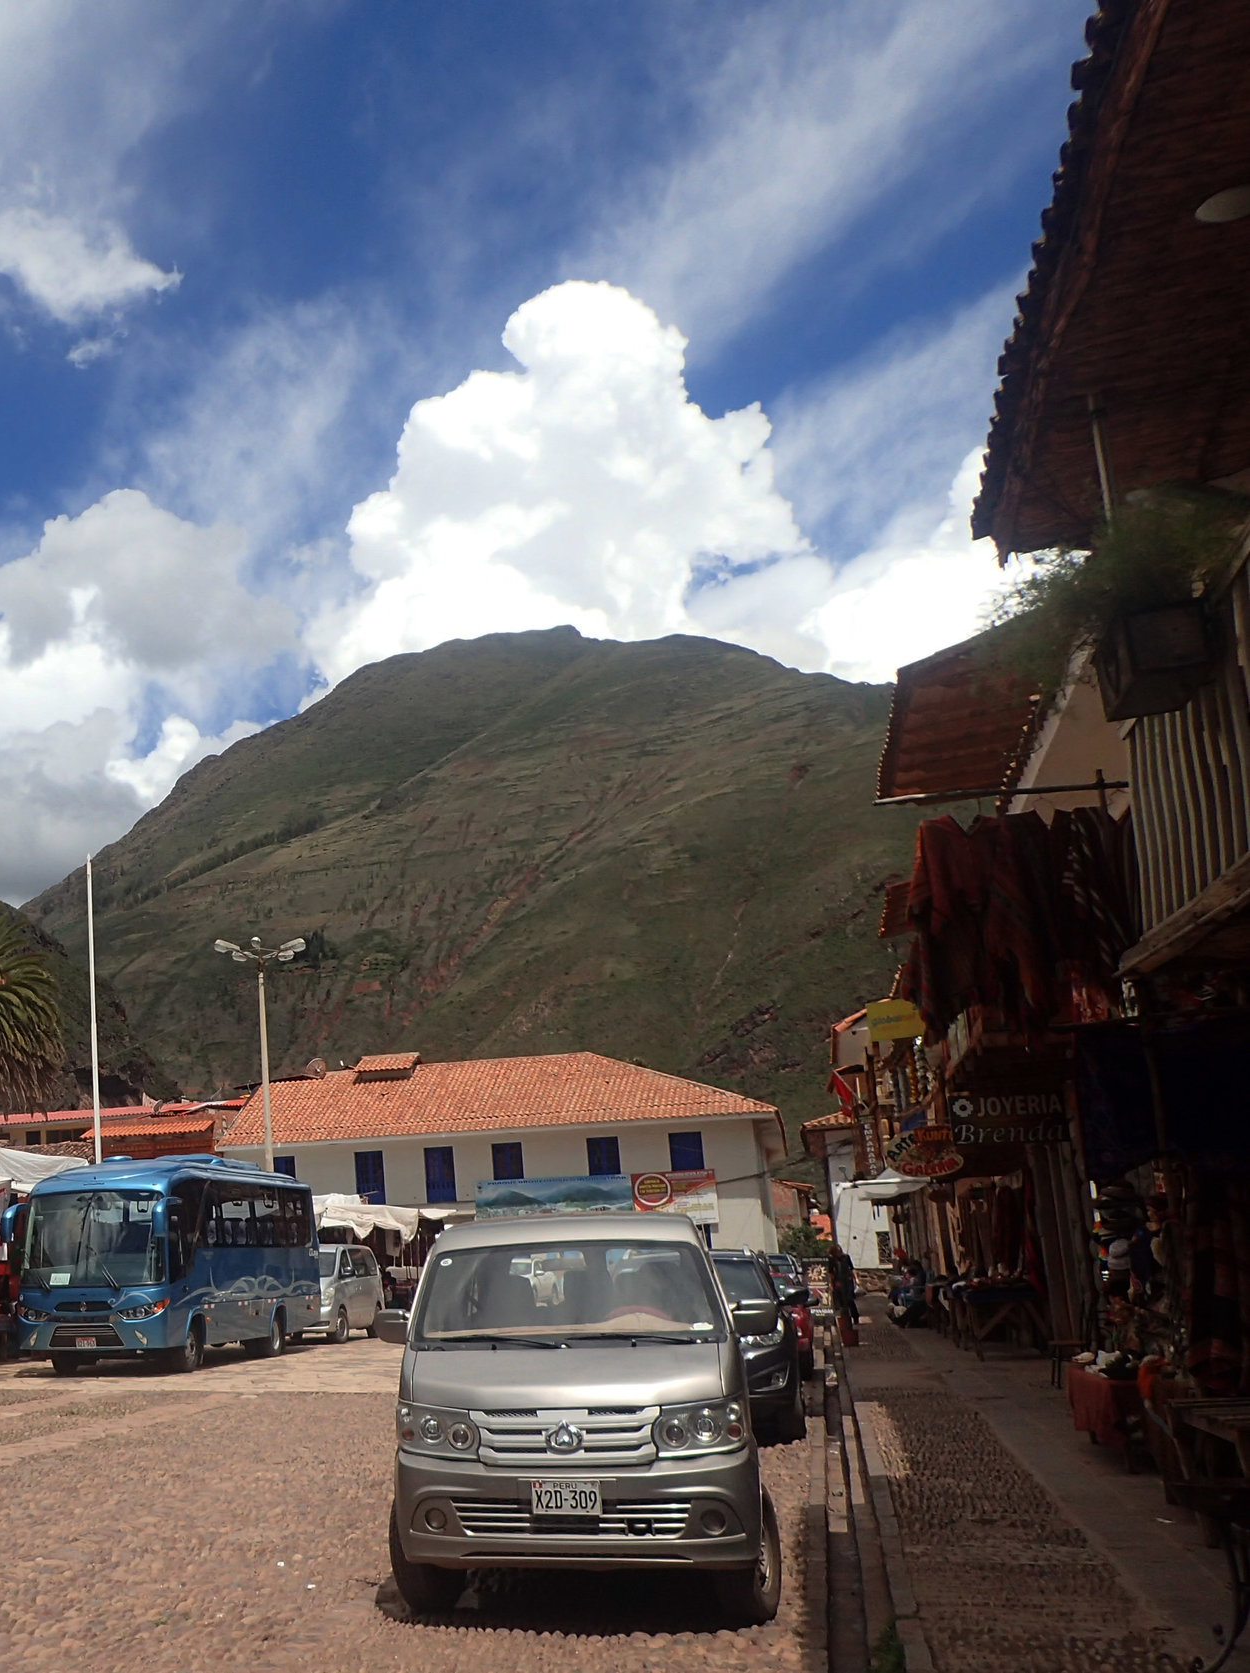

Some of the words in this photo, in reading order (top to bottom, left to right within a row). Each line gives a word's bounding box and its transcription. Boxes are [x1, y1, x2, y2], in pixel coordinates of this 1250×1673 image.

[977, 1094, 1062, 1117] JOYERIA
[954, 1116, 1063, 1145] Brenda
[535, 1490, 598, 1510] X2D-309
